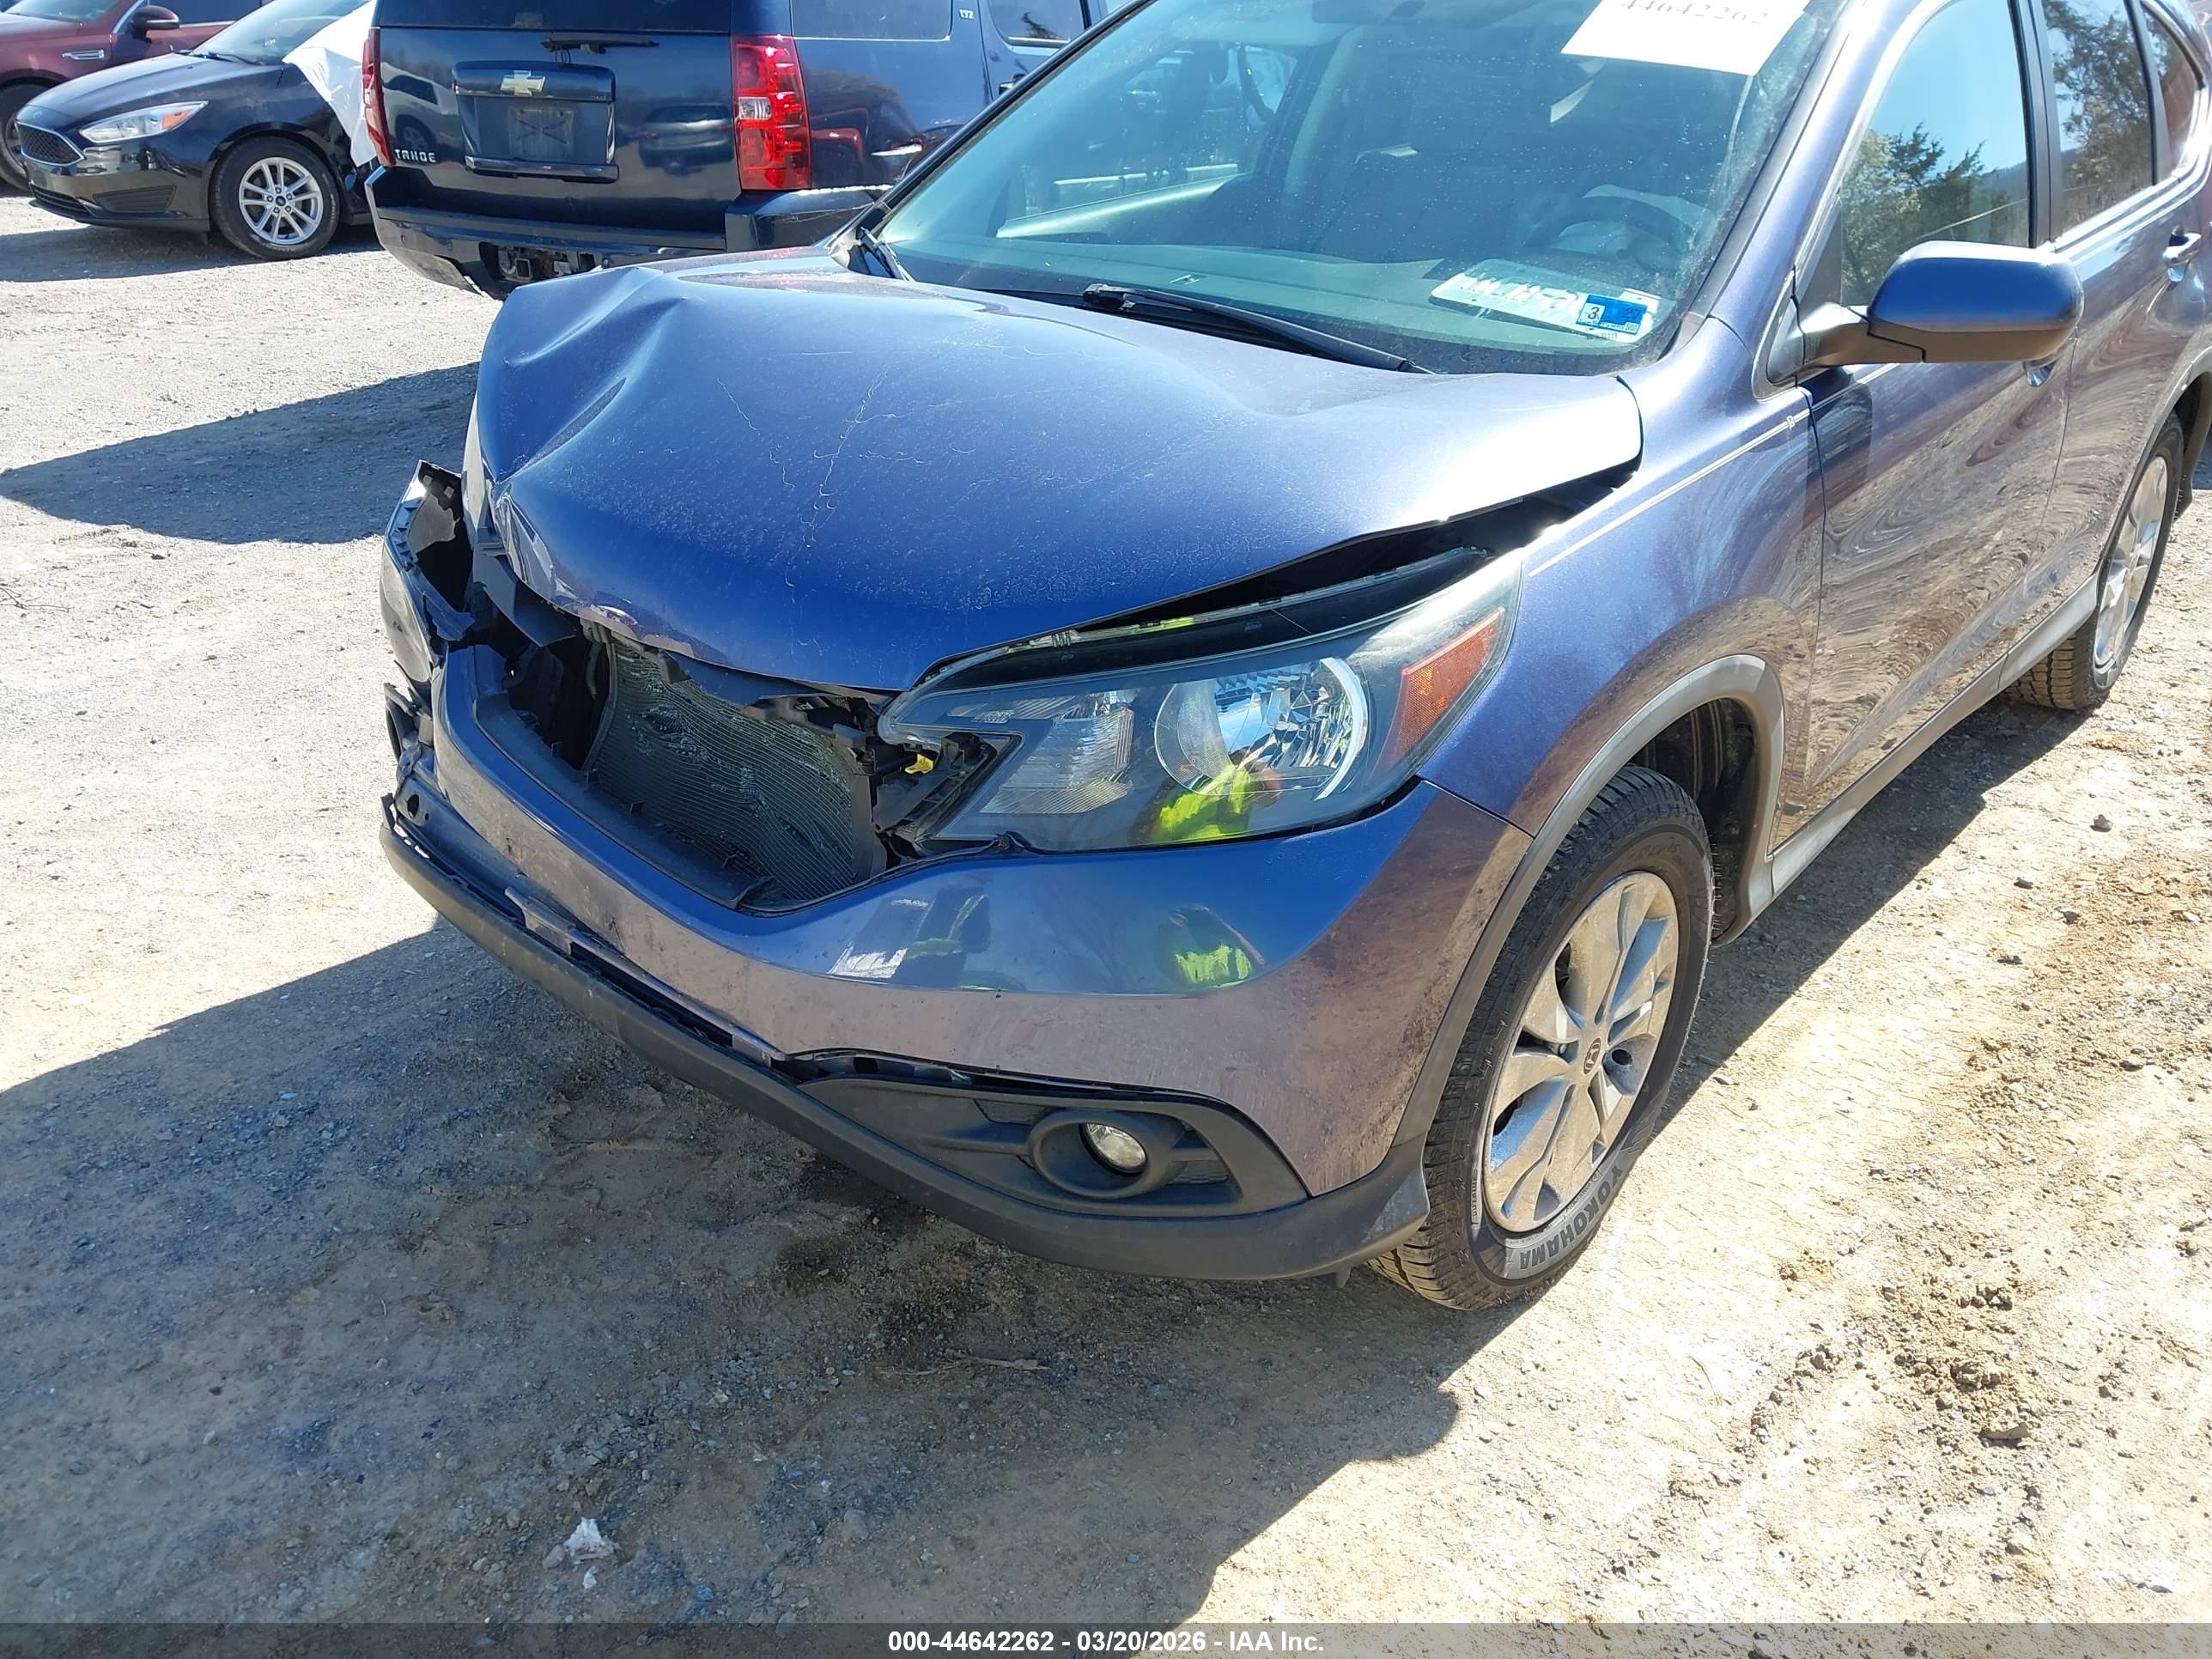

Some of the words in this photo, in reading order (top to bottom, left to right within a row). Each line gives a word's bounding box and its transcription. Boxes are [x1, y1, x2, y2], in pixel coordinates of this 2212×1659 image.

[959, 9, 975, 20] LTZ
[394, 149, 436, 163] TAHOE
[1587, 306, 1600, 320] 3
[1623, 307, 1642, 320] 27
[1517, 1164, 1623, 1270] YOKOHAMA
